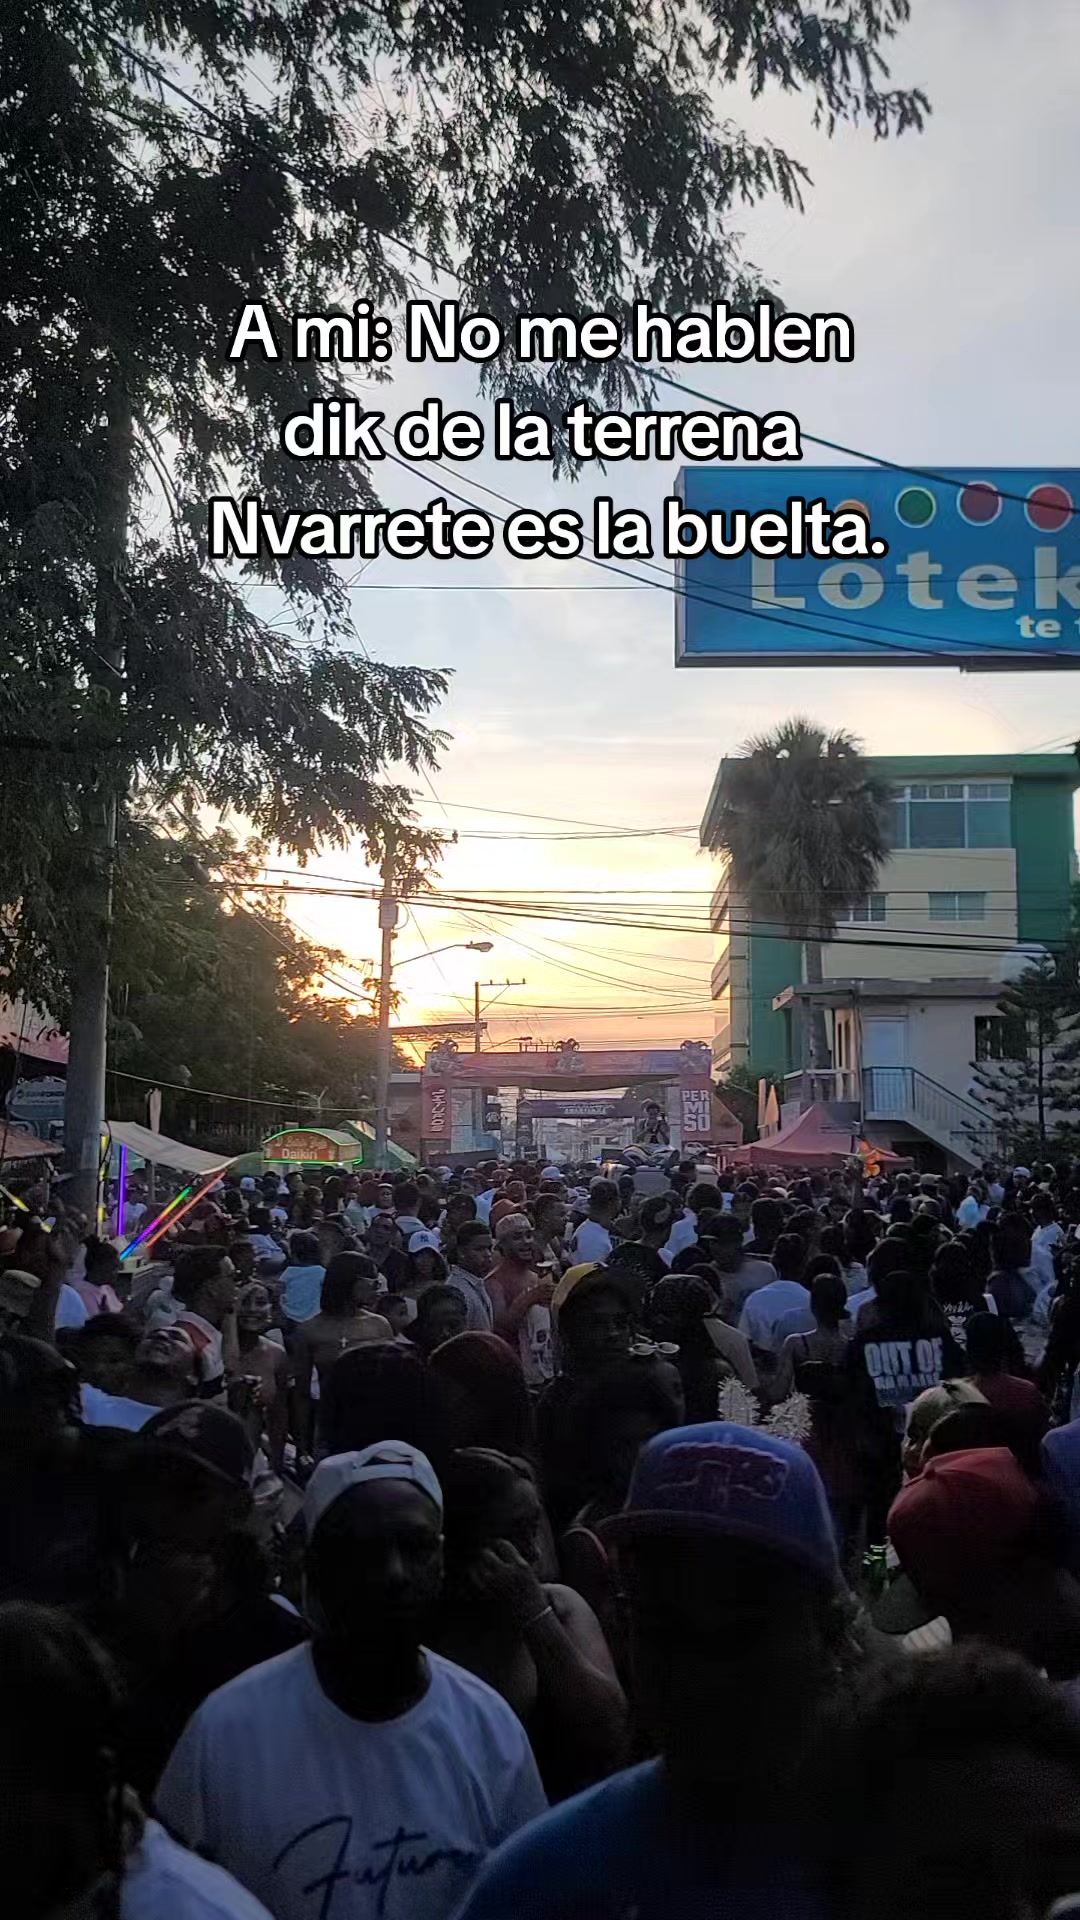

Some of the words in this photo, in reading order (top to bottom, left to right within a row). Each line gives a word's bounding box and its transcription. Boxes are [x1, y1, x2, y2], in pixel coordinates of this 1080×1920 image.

[1015, 614, 1062, 639] te
[681, 1089, 710, 1102] PER
[683, 1101, 711, 1114] MI
[683, 1113, 711, 1132] SO
[864, 1340, 912, 1377] OUT
[915, 1336, 944, 1374] OF
